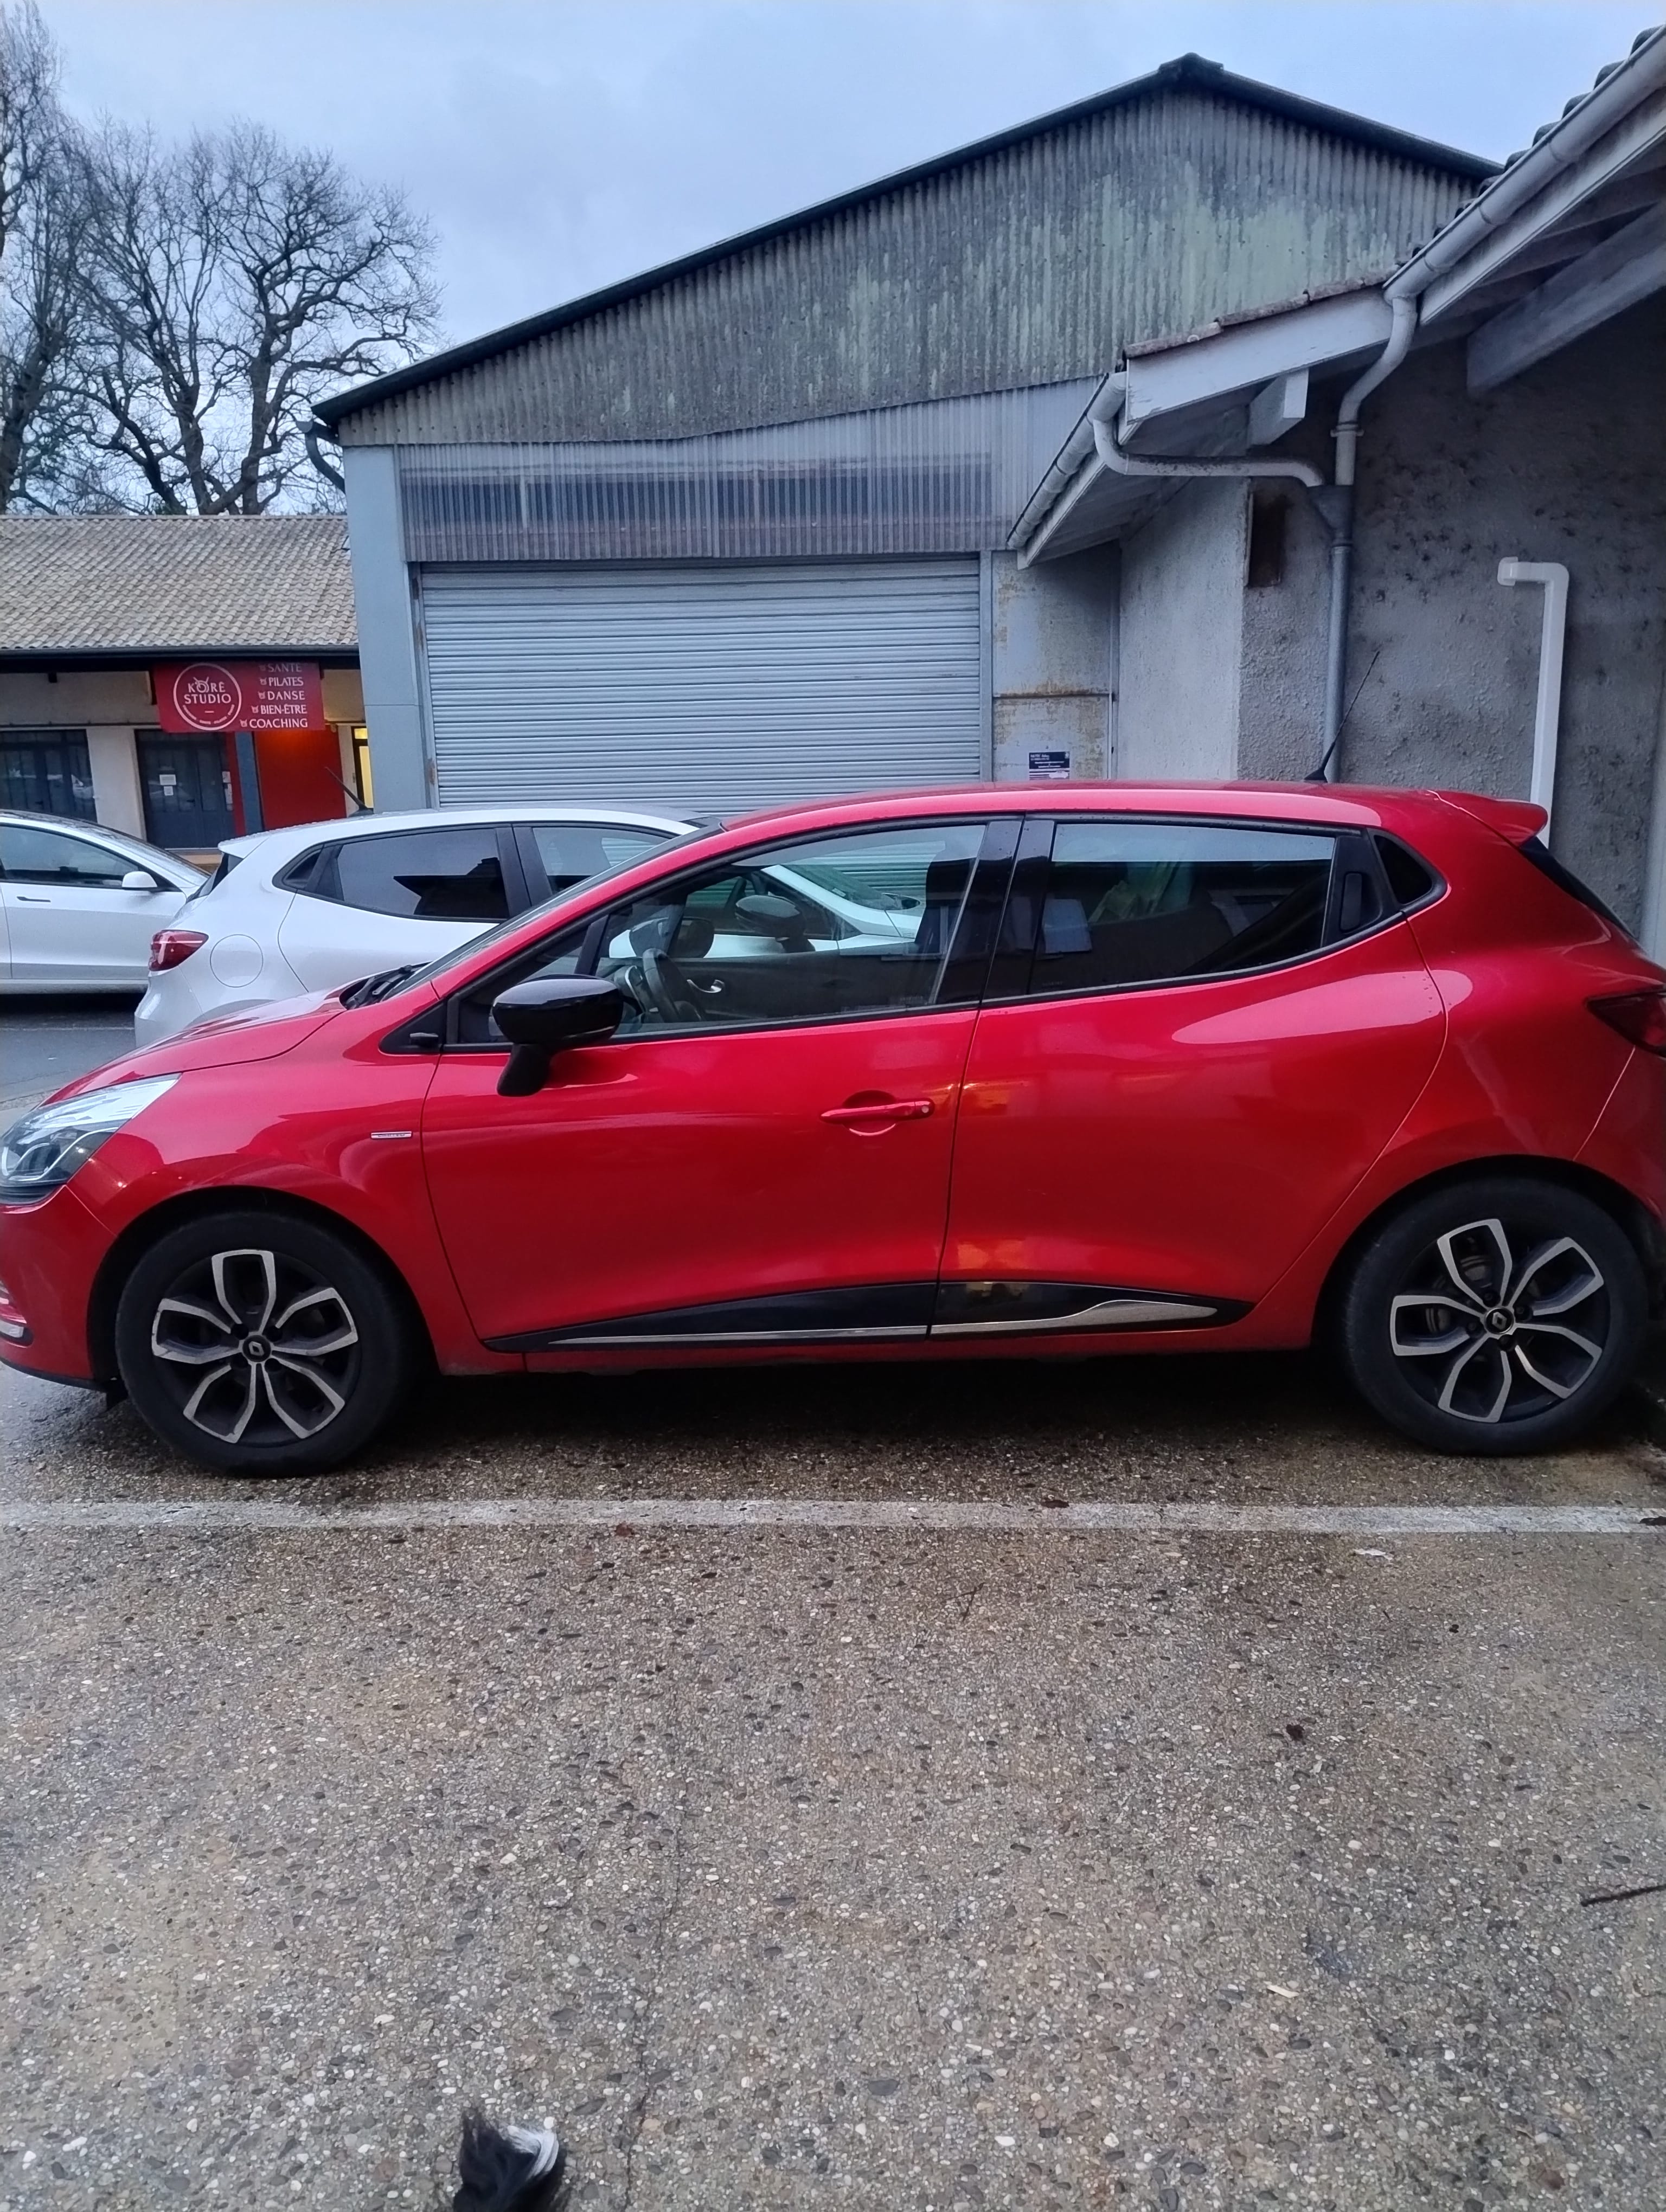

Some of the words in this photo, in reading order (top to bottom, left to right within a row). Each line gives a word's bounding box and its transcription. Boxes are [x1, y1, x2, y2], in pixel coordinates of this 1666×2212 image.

[268, 677, 304, 686] PILATES
[184, 693, 232, 704] STUDIO
[267, 691, 305, 700] DANSE
[249, 718, 308, 729] COACHING
